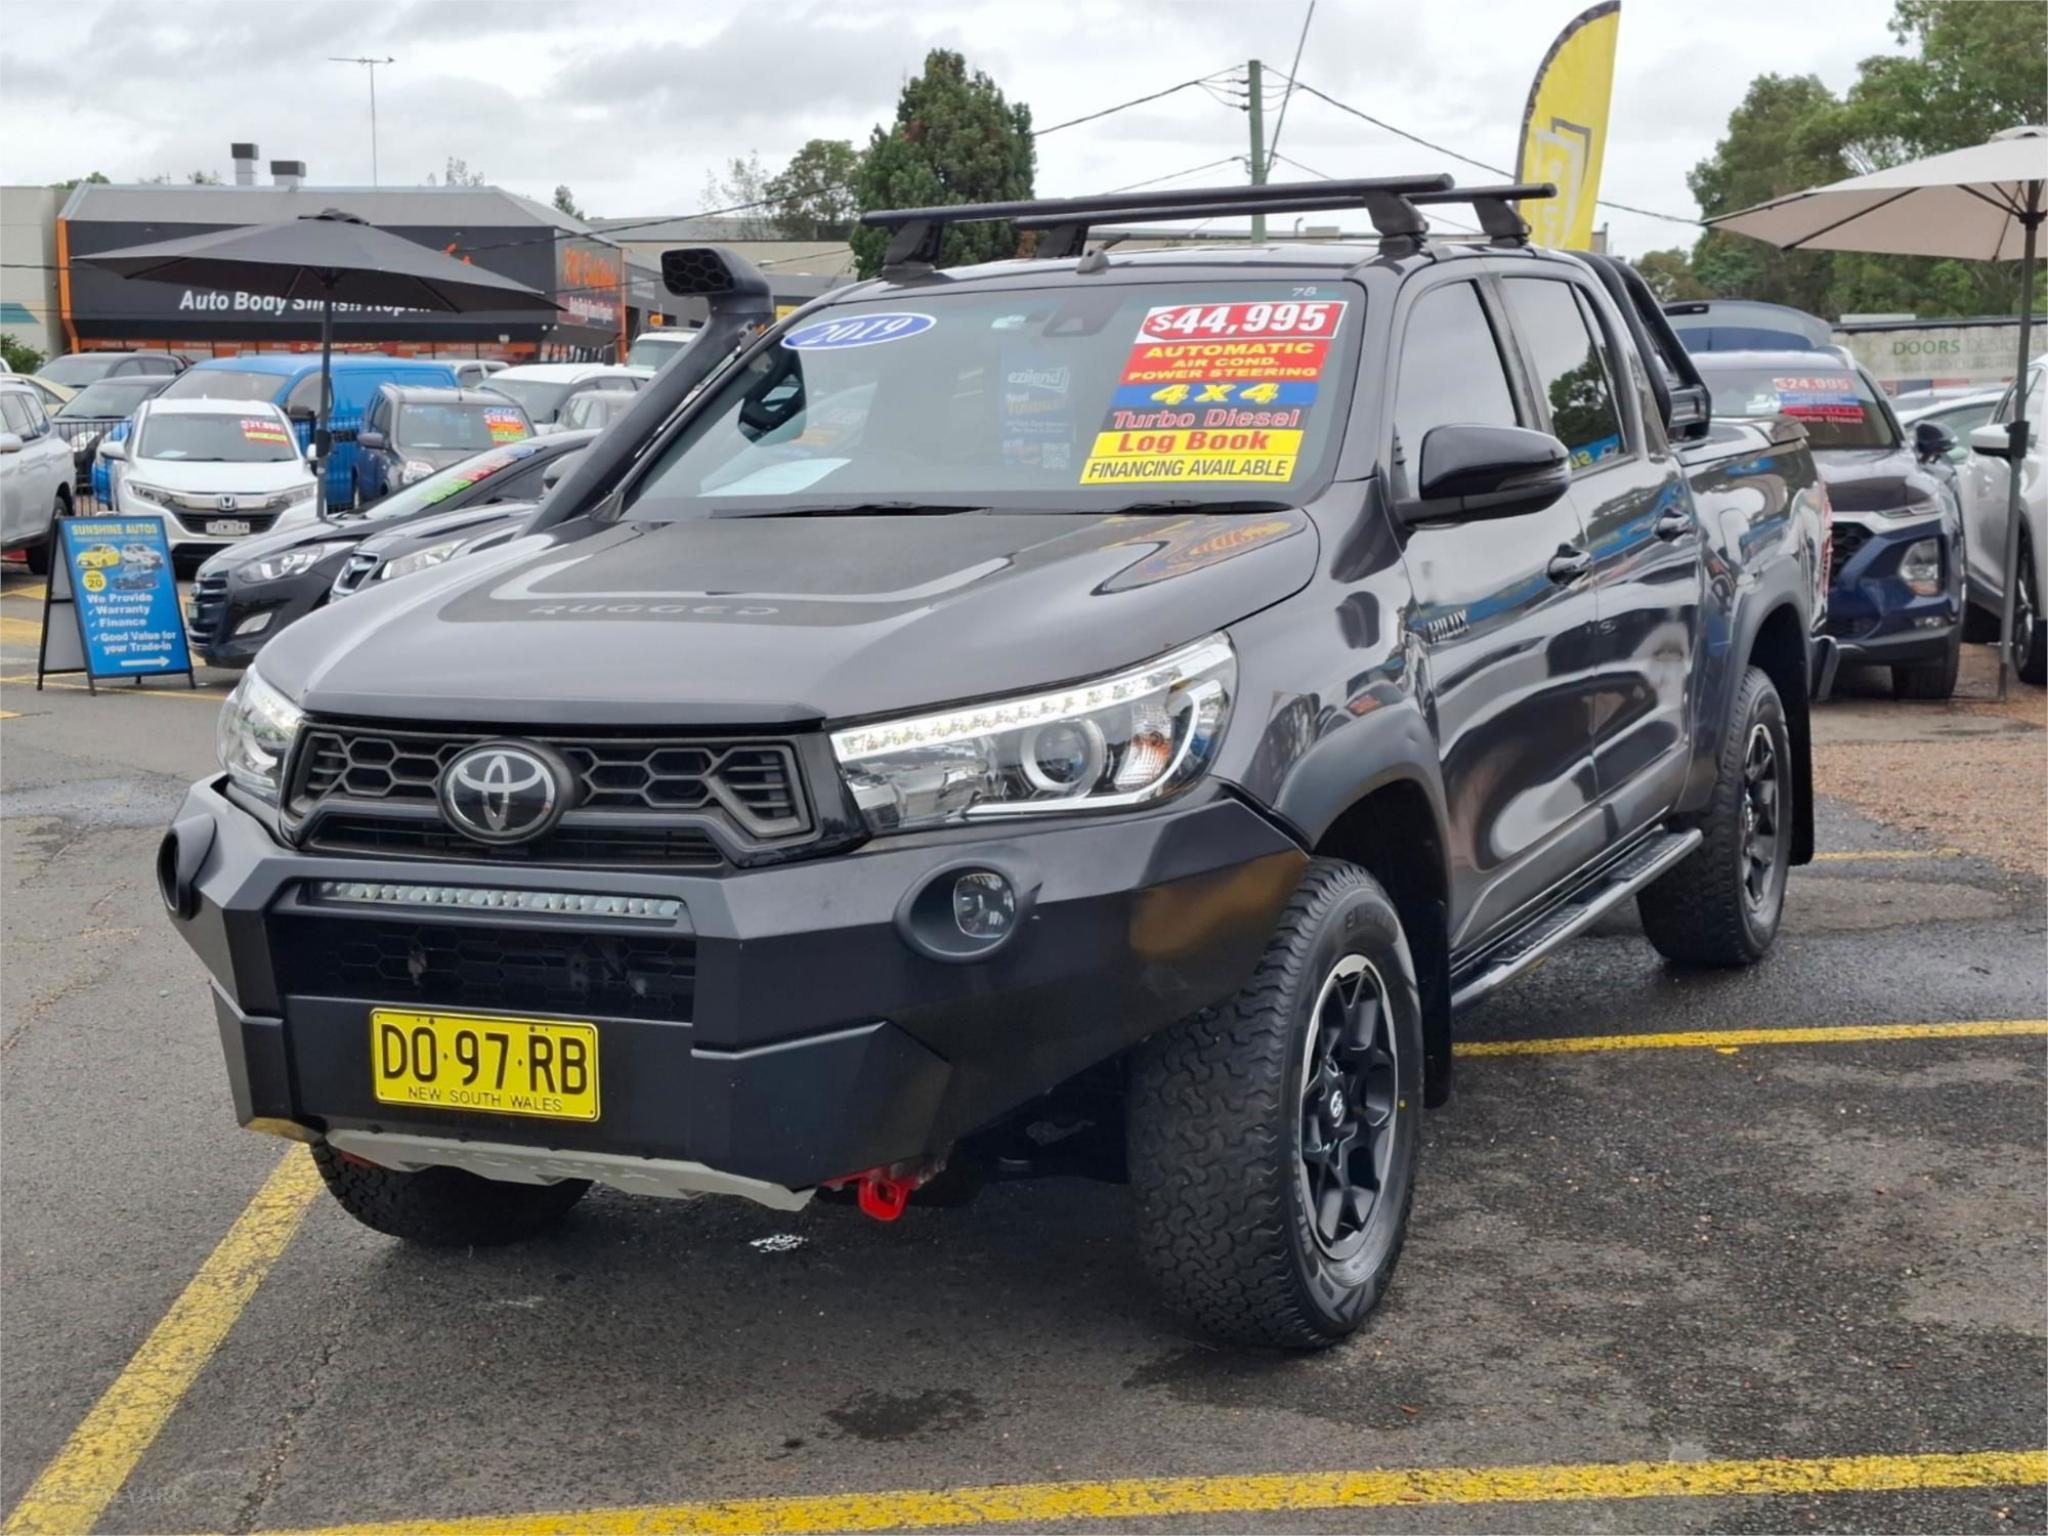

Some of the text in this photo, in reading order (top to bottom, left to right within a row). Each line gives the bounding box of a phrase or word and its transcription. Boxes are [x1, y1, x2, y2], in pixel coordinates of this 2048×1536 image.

[1290, 286, 1319, 298] 78
[178, 289, 229, 311] Auto
[233, 290, 287, 317] Body
[1151, 304, 1330, 336] $44,995
[799, 317, 913, 345] 2019
[1143, 342, 1316, 359] AUTOMATIC
[1893, 340, 1961, 356] DOORS
[1172, 356, 1280, 369] AIR COND.
[1127, 366, 1318, 381] POWER STEERING
[1150, 383, 1190, 405] 4
[1239, 382, 1280, 405] 4
[1112, 408, 1301, 430] Turbo Diesel
[1797, 414, 1824, 424] urbo
[1117, 431, 1270, 454] Log Book
[1088, 458, 1288, 479] FINANCING AVAILABLE
[71, 523, 159, 536] SUNSHINE AUTOS
[86, 593, 153, 604] We Provide
[96, 605, 150, 616] Warranty
[528, 604, 780, 615] RUGGED
[99, 617, 147, 627] Finance
[1428, 608, 1468, 643] HILUX
[100, 630, 176, 642] Good Value for
[103, 641, 172, 655] your Trade-in
[408, 1086, 563, 1112] NEW SOUTH WALES
